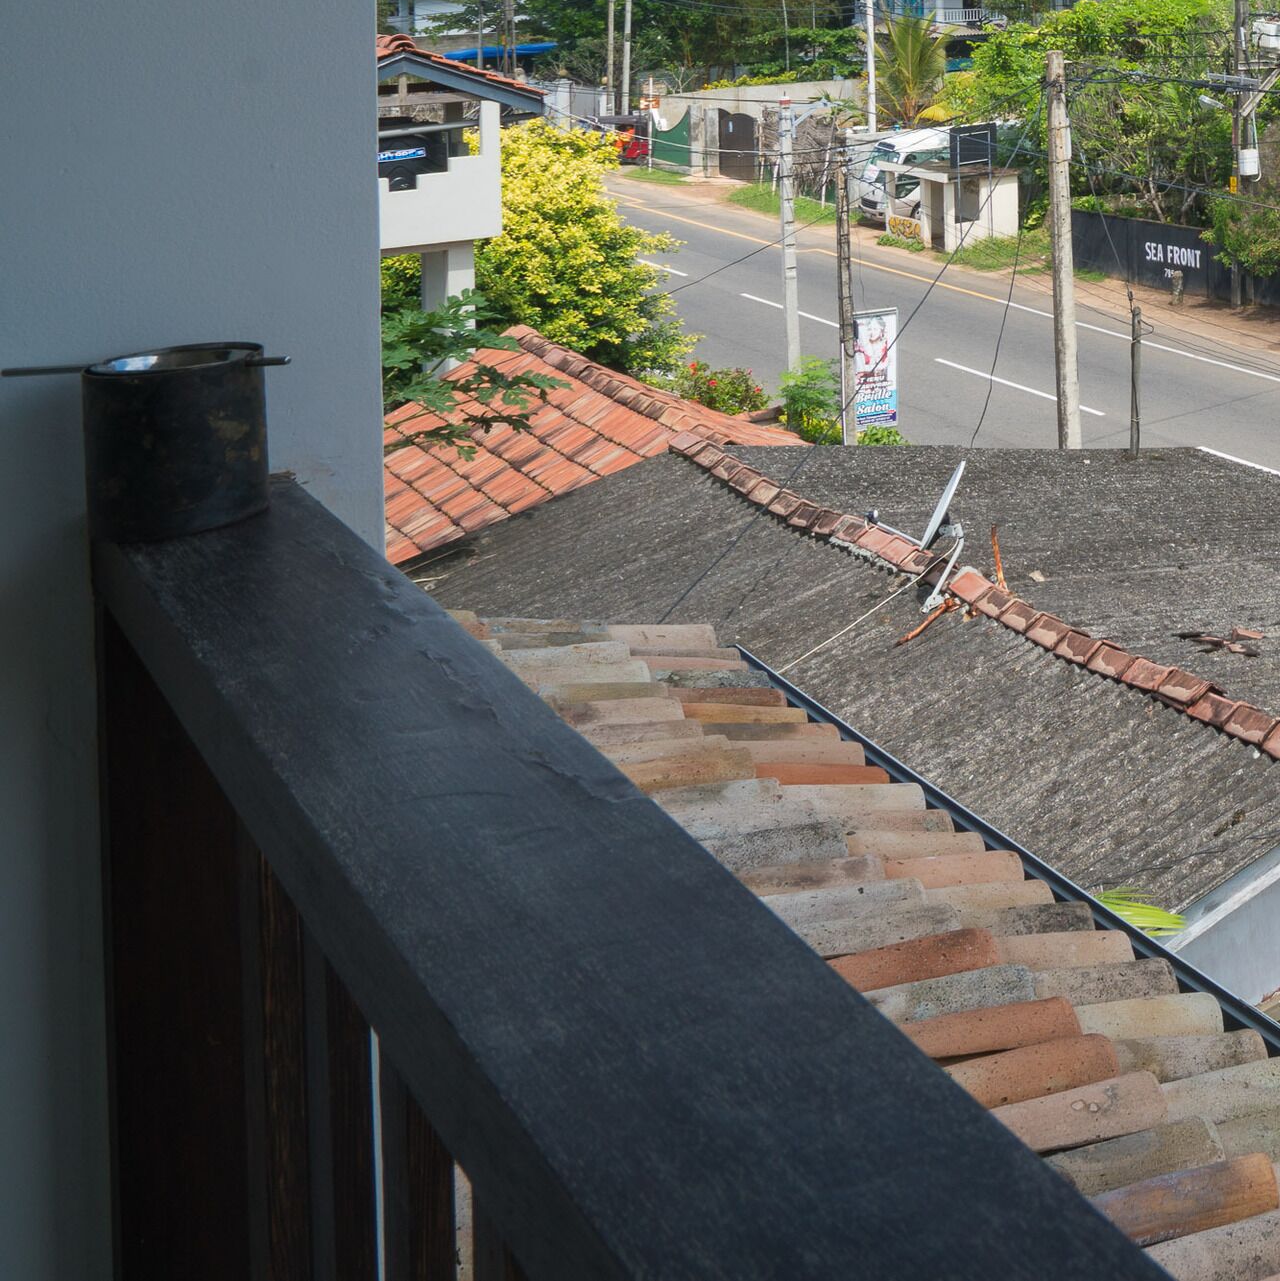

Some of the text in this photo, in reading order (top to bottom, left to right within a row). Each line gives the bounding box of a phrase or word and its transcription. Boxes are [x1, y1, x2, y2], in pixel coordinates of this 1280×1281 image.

[1145, 242, 1201, 269] SEA FRONT
[857, 403, 889, 414] Salon
